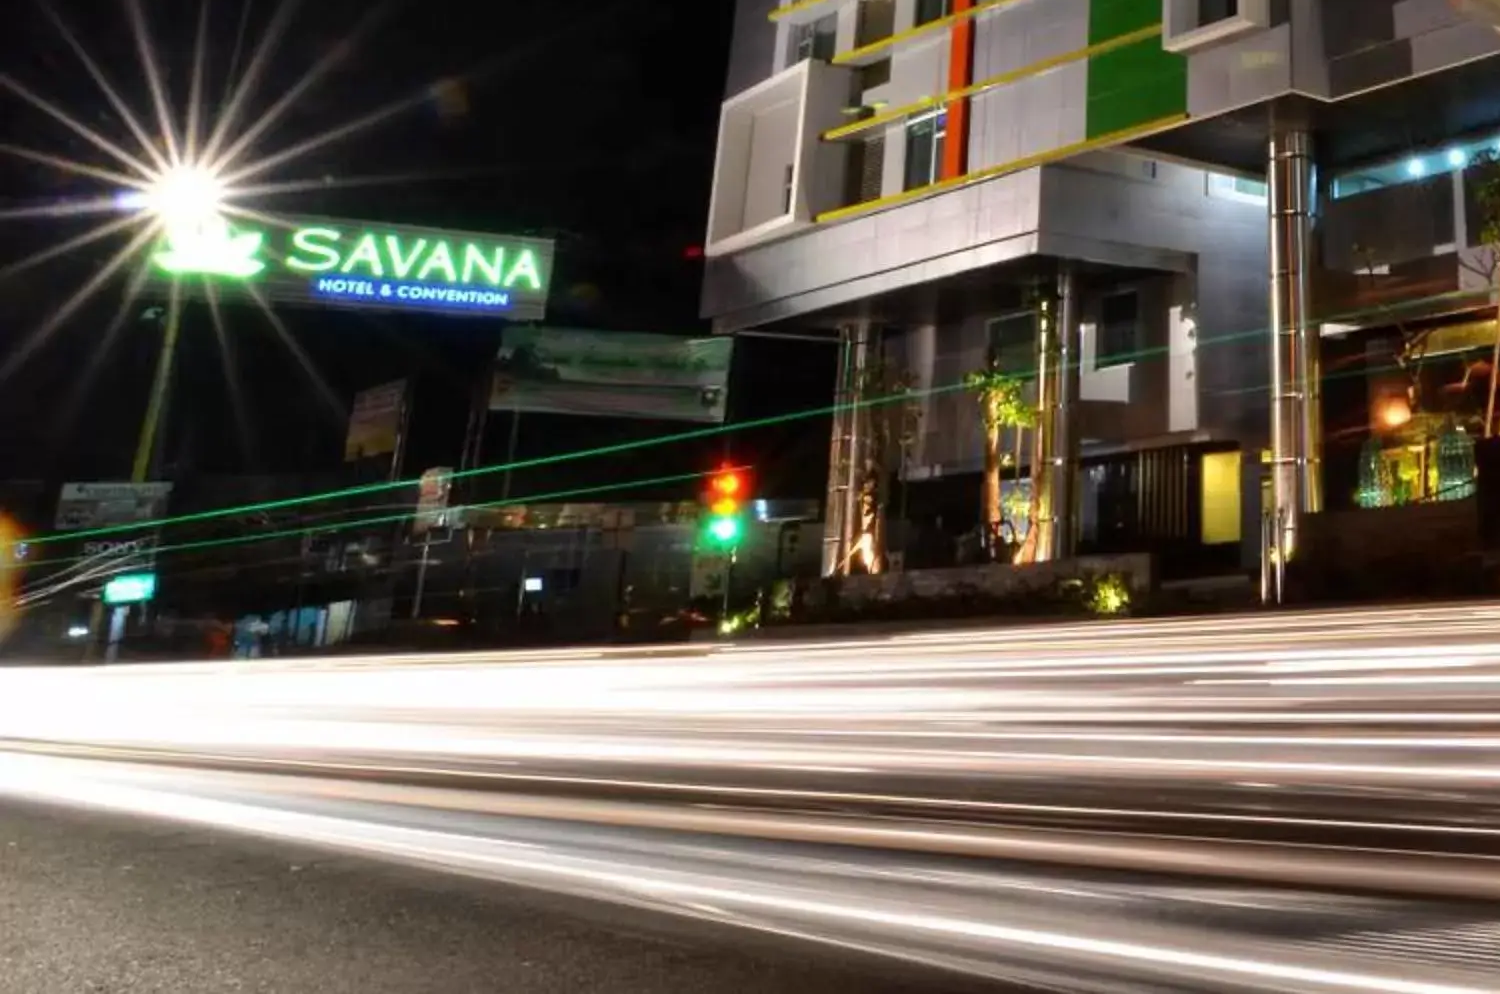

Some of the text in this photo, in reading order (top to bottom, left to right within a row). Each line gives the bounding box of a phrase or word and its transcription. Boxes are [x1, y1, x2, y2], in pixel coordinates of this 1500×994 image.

[285, 226, 542, 290] SAVANA
[318, 278, 509, 306] HOTEL & CONVENTION
